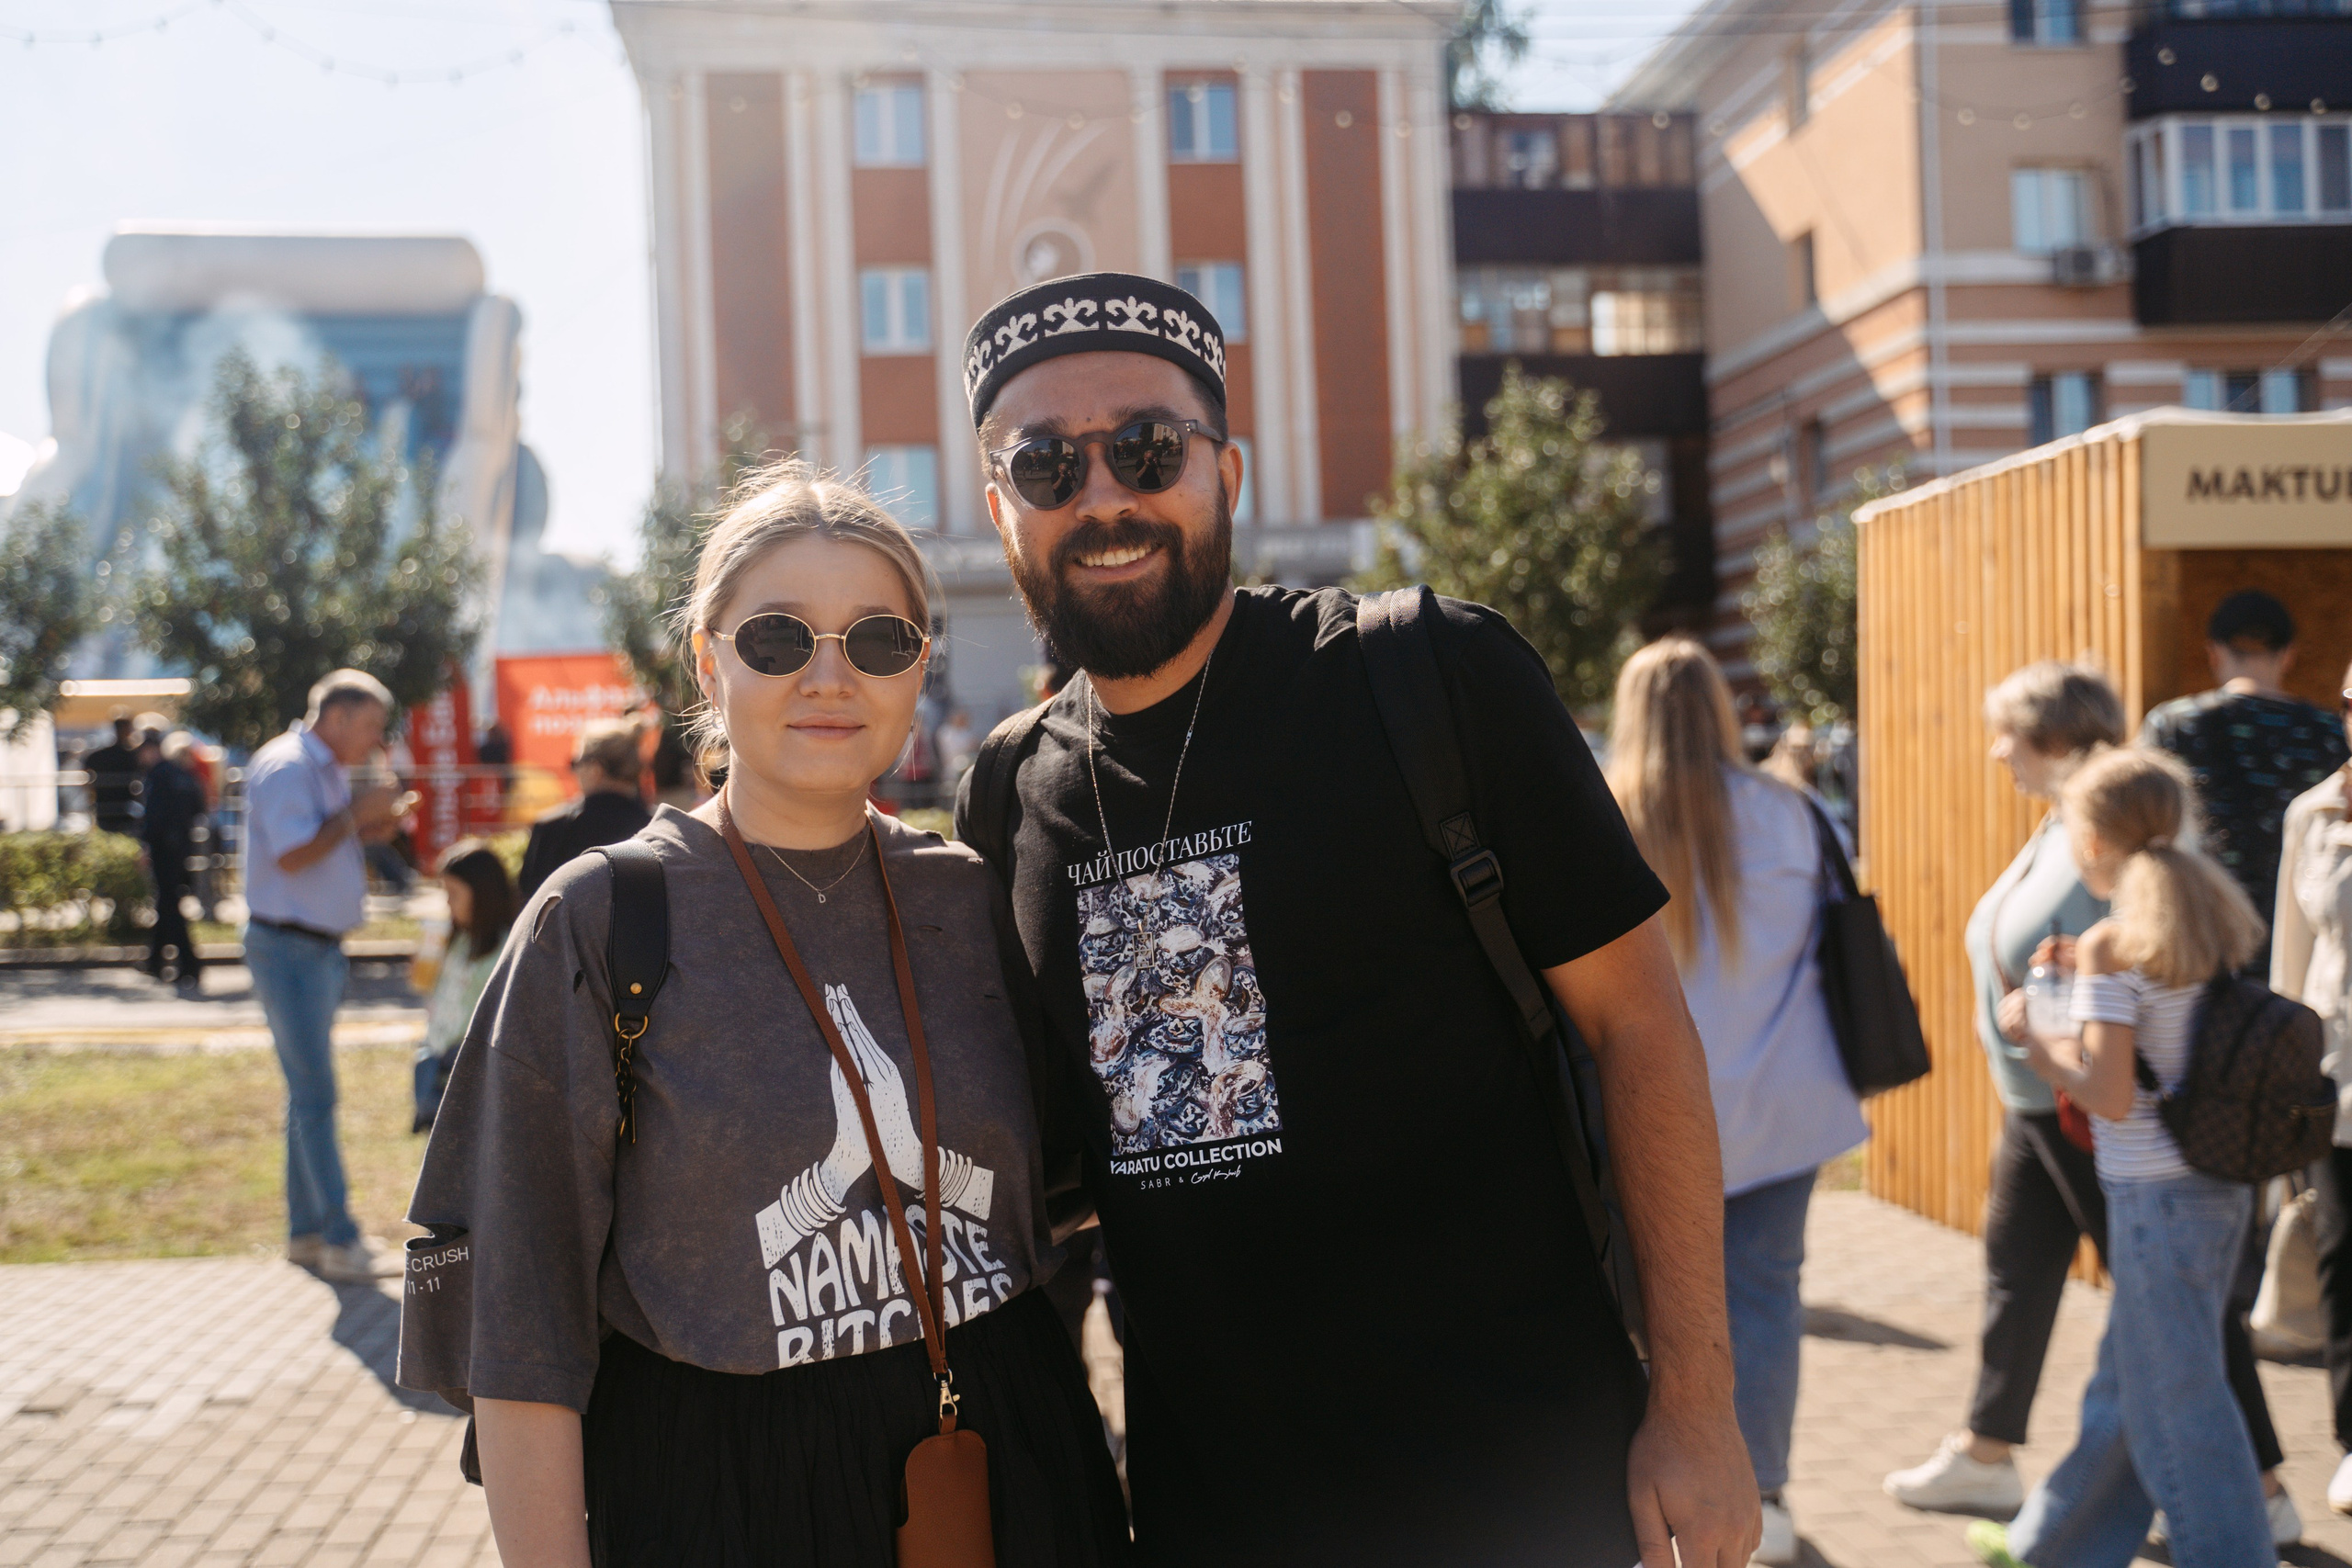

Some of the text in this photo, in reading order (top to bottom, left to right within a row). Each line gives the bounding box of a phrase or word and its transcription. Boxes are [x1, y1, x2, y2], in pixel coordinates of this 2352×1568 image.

[2187, 464, 2351, 504] MAKTU
[1067, 820, 1252, 886] ЧАЙ ПОСТАВЬТЕ
[1164, 1138, 1283, 1169] COLLECTION
[1140, 1176, 1171, 1190] SABR
